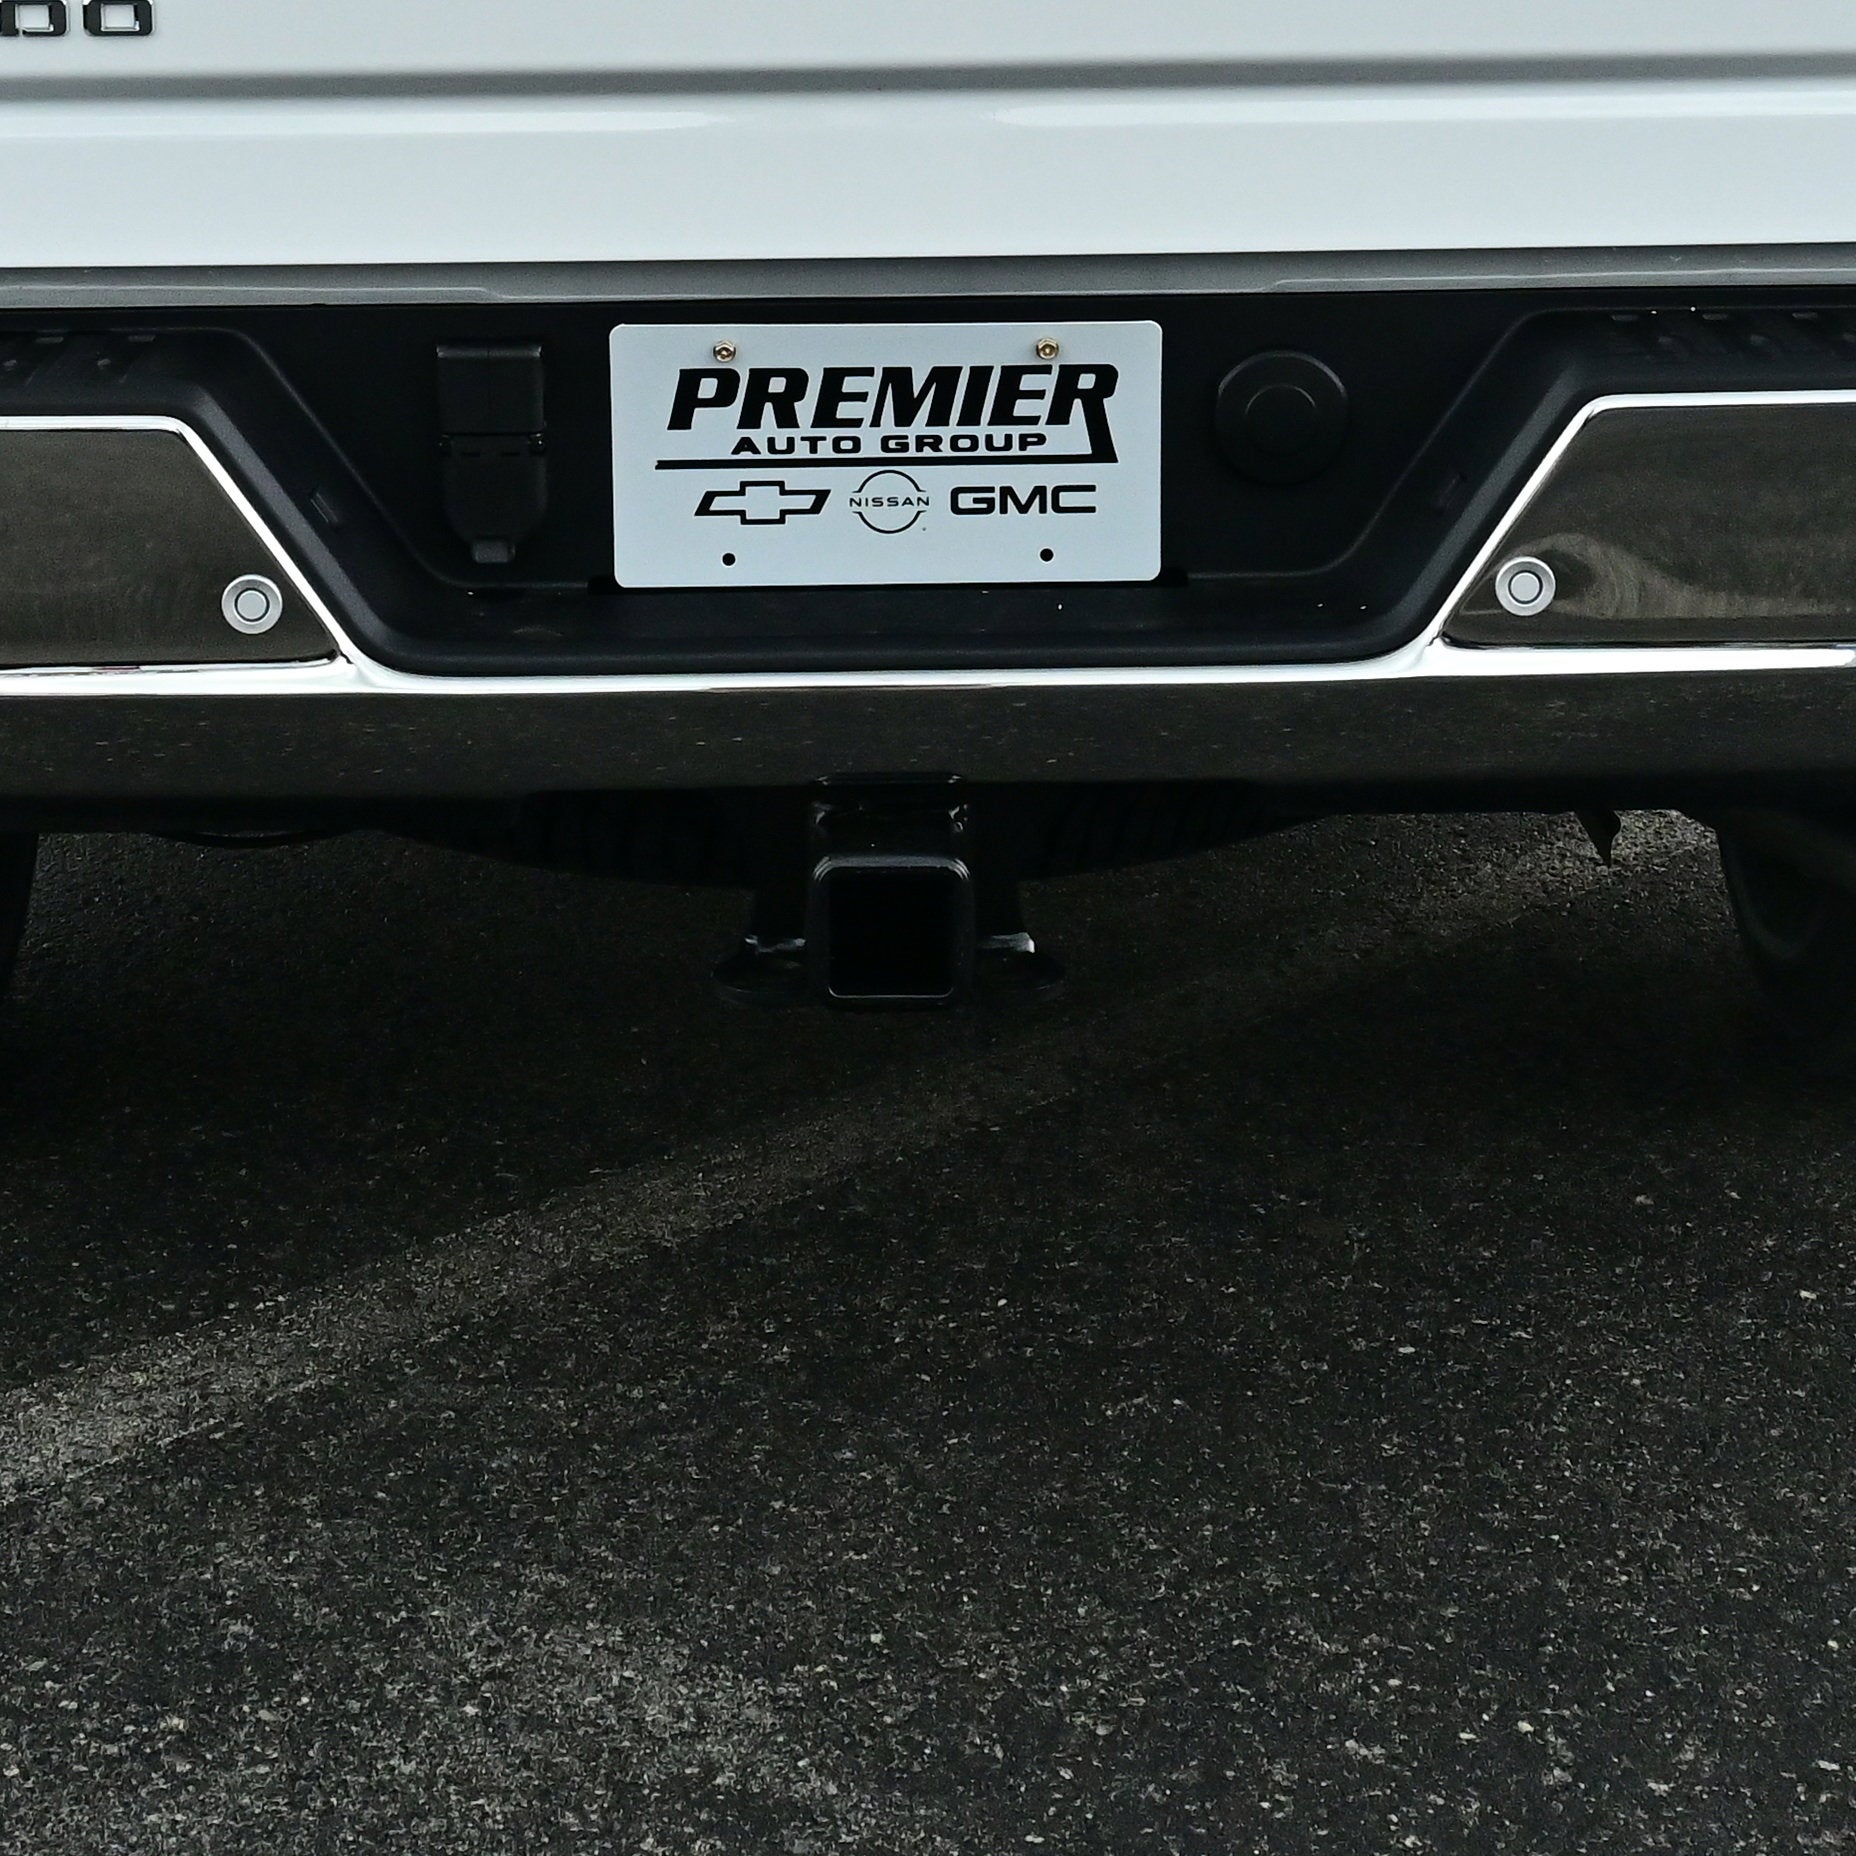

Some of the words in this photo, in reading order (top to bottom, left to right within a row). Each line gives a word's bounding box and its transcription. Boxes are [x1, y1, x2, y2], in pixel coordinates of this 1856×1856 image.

[666, 363, 1119, 440] PREMIER
[730, 435, 862, 456] AUTO
[879, 433, 1047, 455] GROUP
[848, 496, 930, 507] NISSAN
[949, 484, 1097, 515] GMC
